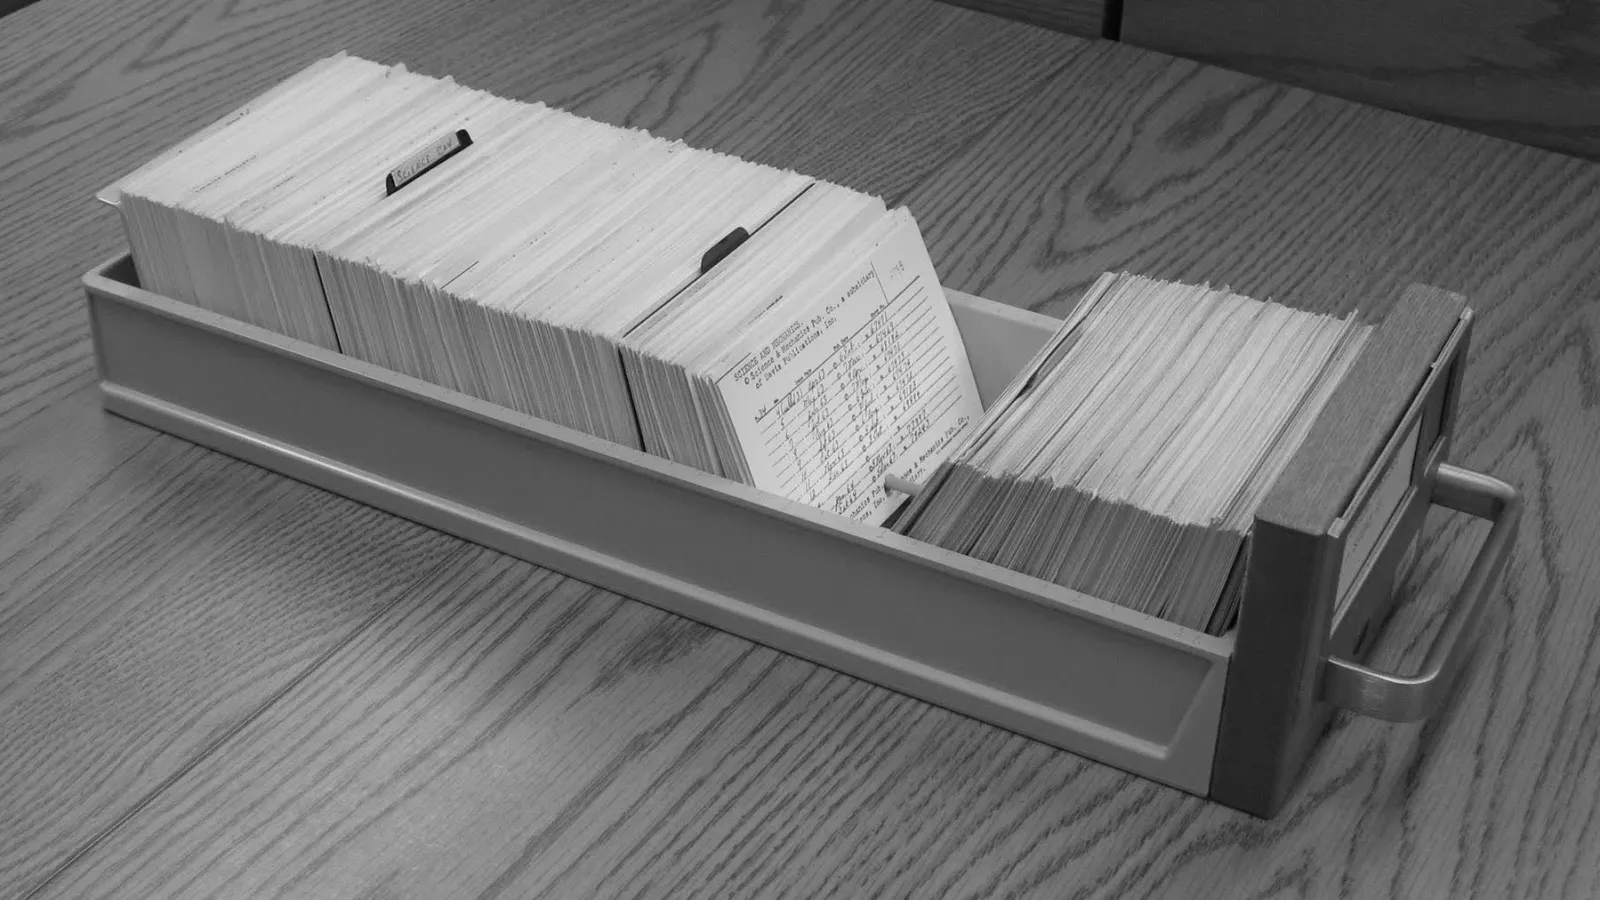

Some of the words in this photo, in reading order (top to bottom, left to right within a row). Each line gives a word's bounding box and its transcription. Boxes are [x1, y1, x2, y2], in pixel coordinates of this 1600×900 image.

[733, 356, 759, 382] SCIENCE
[759, 346, 771, 360] AND
[749, 356, 775, 380] Science
[780, 325, 810, 354] Mechanics
[755, 377, 763, 389] of
[763, 363, 782, 381] Davis
